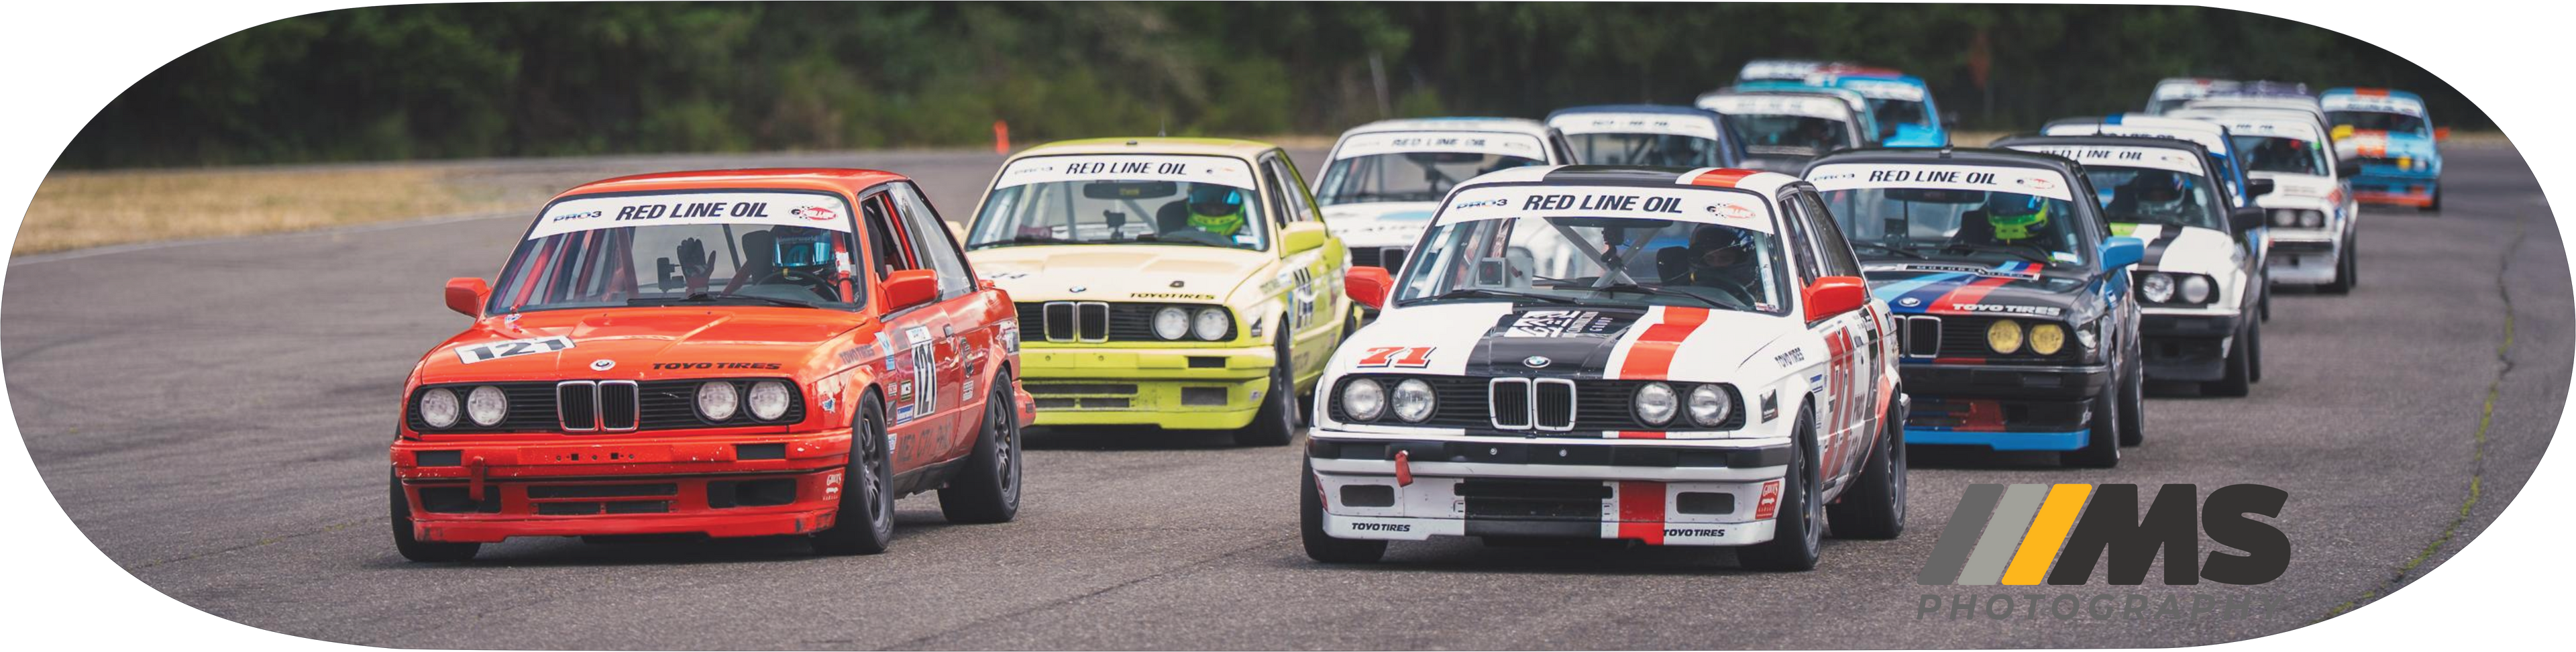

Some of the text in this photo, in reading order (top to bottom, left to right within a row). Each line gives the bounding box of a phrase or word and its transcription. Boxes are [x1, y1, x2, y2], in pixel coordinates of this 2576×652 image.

[1066, 162, 1187, 174] RED LINE OIL
[1869, 170, 1909, 182] RED
[1915, 171, 1959, 182] LINE
[1966, 172, 1997, 184] OIL
[615, 202, 768, 221] RED LINE OIL
[1456, 199, 1507, 209] PRO3
[1523, 195, 1682, 213] RED LINE OIL
[553, 211, 602, 223] PRO3
[1952, 303, 2061, 316] TOYO TIRES
[467, 339, 566, 361] 121
[839, 344, 875, 364] TOYO TIRES
[1357, 346, 1437, 368] 71
[1774, 347, 1805, 368] TOYO TIRES
[914, 343, 936, 416] 121
[1352, 523, 1411, 532] TOYO TIRES
